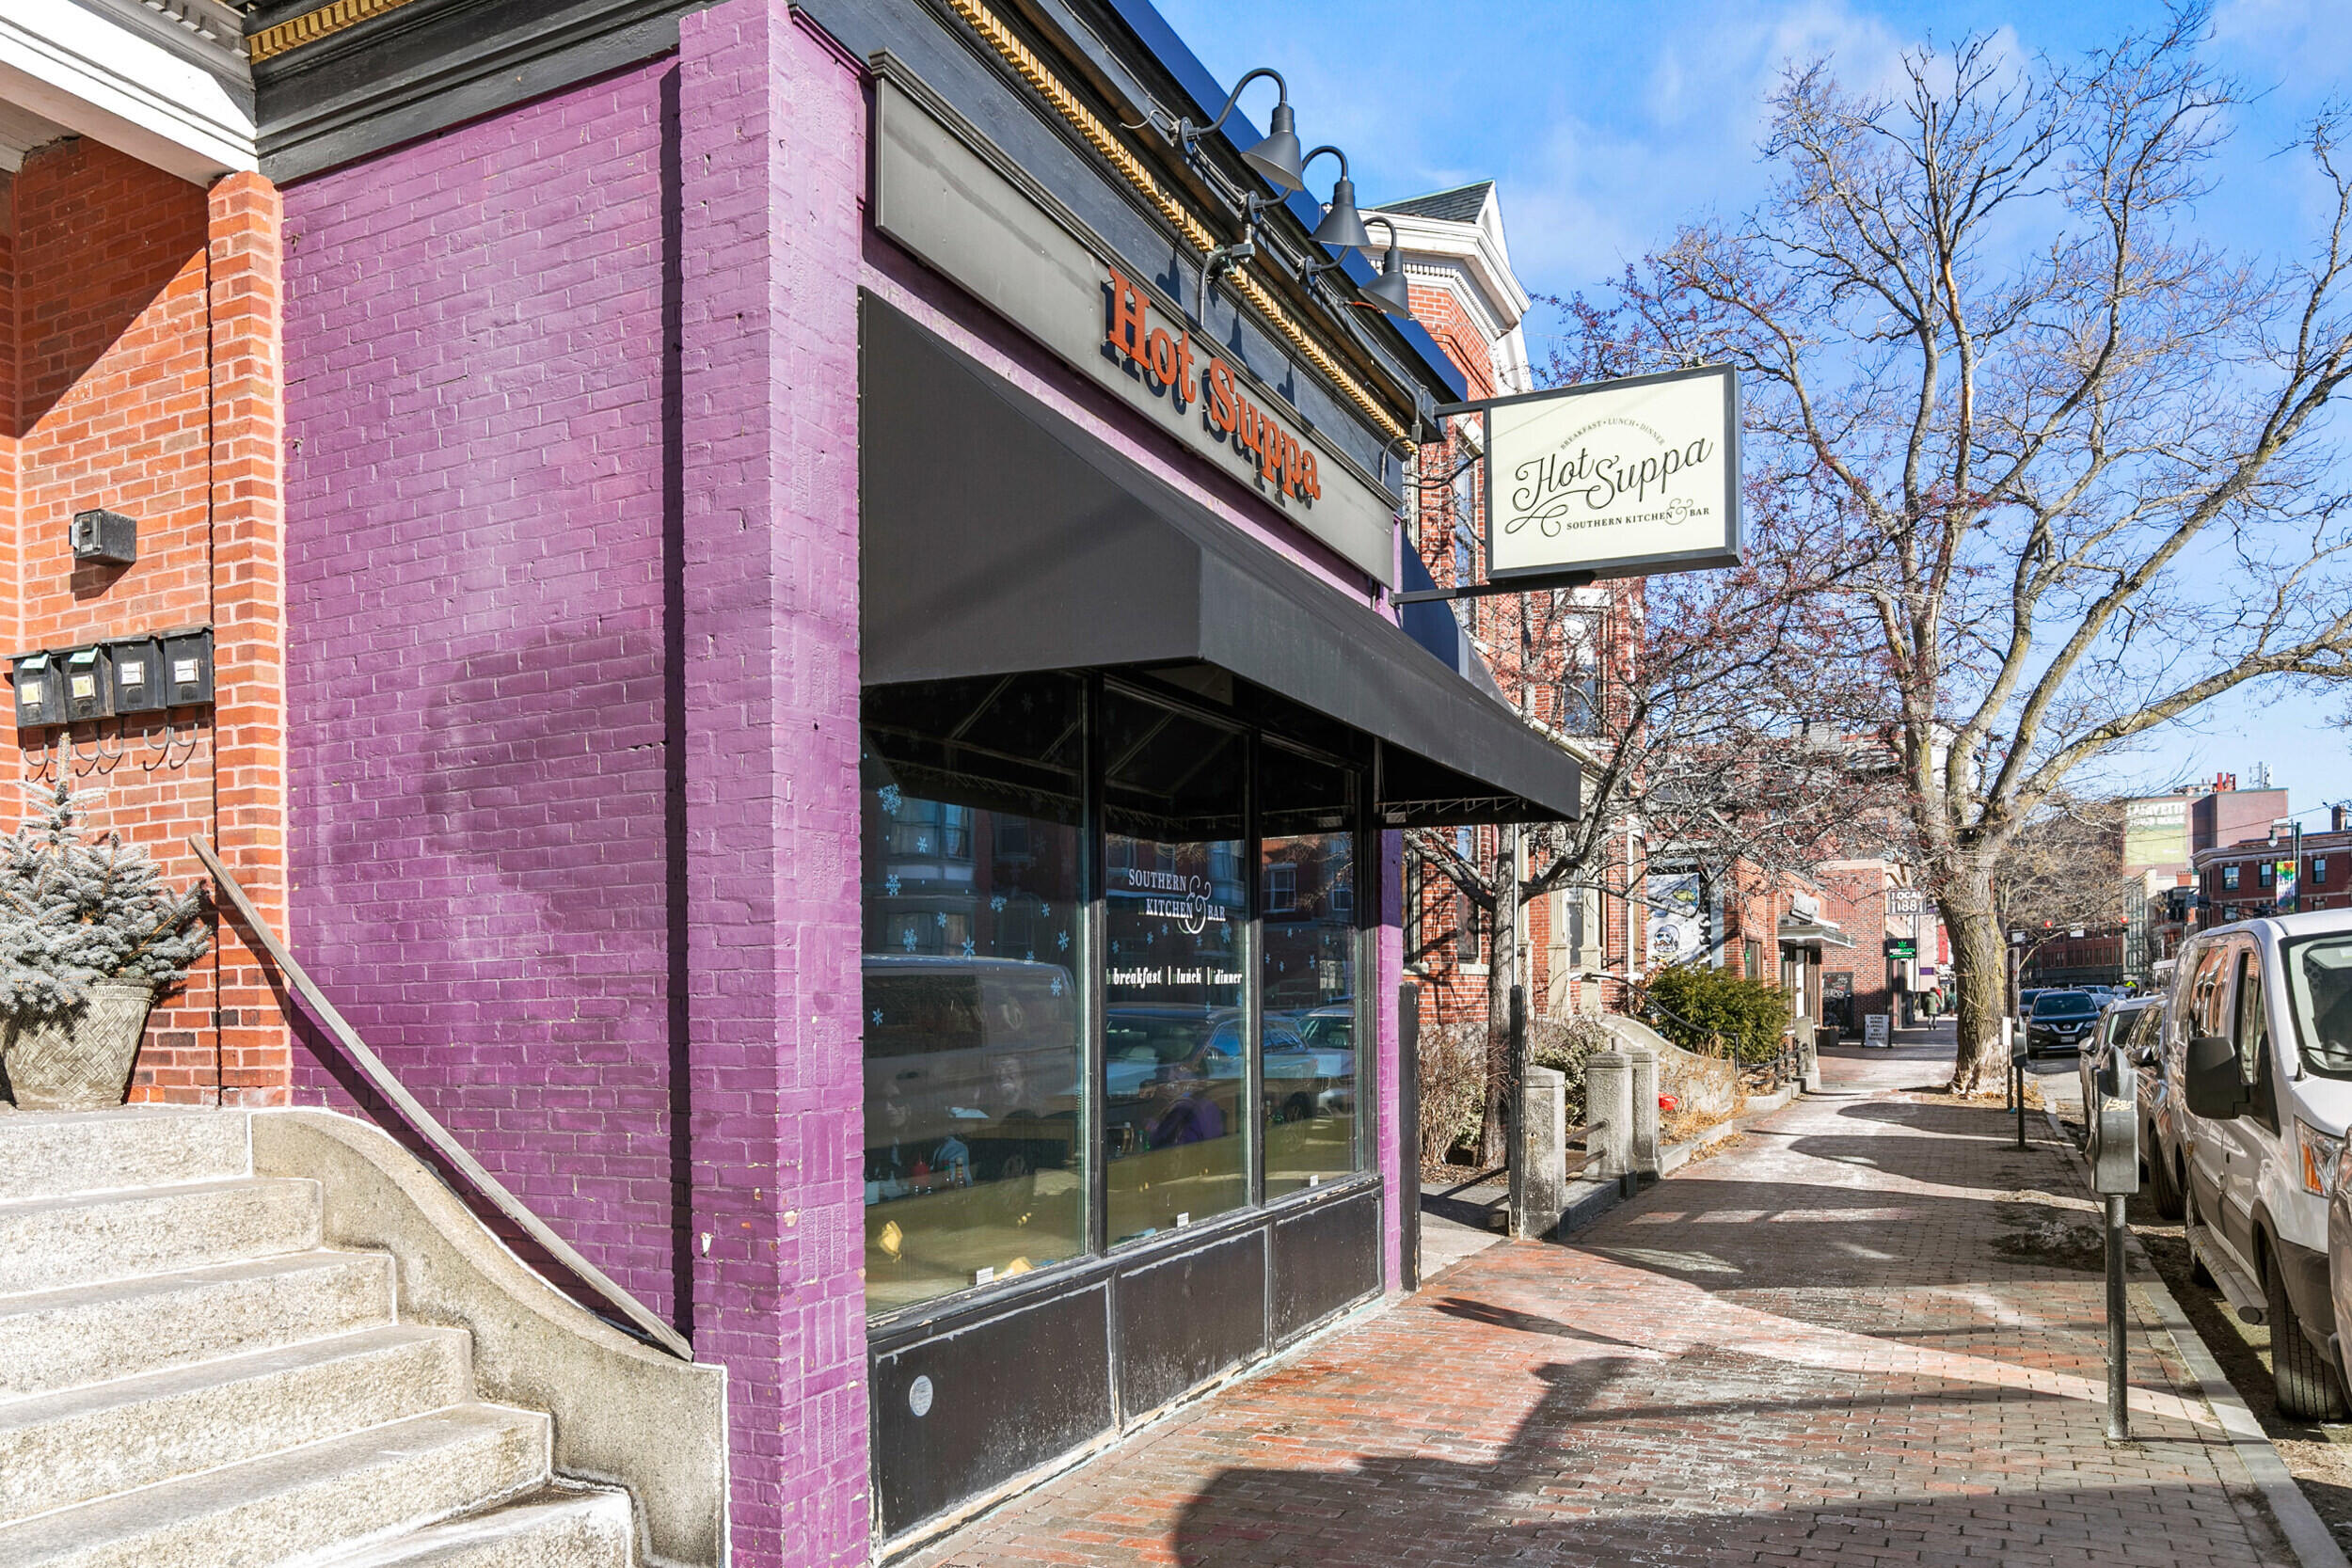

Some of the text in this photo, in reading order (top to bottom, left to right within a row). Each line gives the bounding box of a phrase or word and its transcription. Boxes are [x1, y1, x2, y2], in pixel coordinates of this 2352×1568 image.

[1108, 264, 1322, 500] Hot Suppa
[1560, 418, 1665, 451] BREAKFAST LUNCH DINNER
[1512, 436, 1714, 512] Hot Suppa
[1565, 515, 1623, 531] SOUTHERN
[1625, 511, 1674, 526] KITCHEN
[1689, 506, 1710, 517] BAR
[1128, 868, 1187, 893] SOUTHERN
[1891, 891, 1926, 901] LOCAL
[1145, 898, 1226, 922] KITCHEN BAR
[1112, 967, 1242, 989] breakfast lunch dinner
